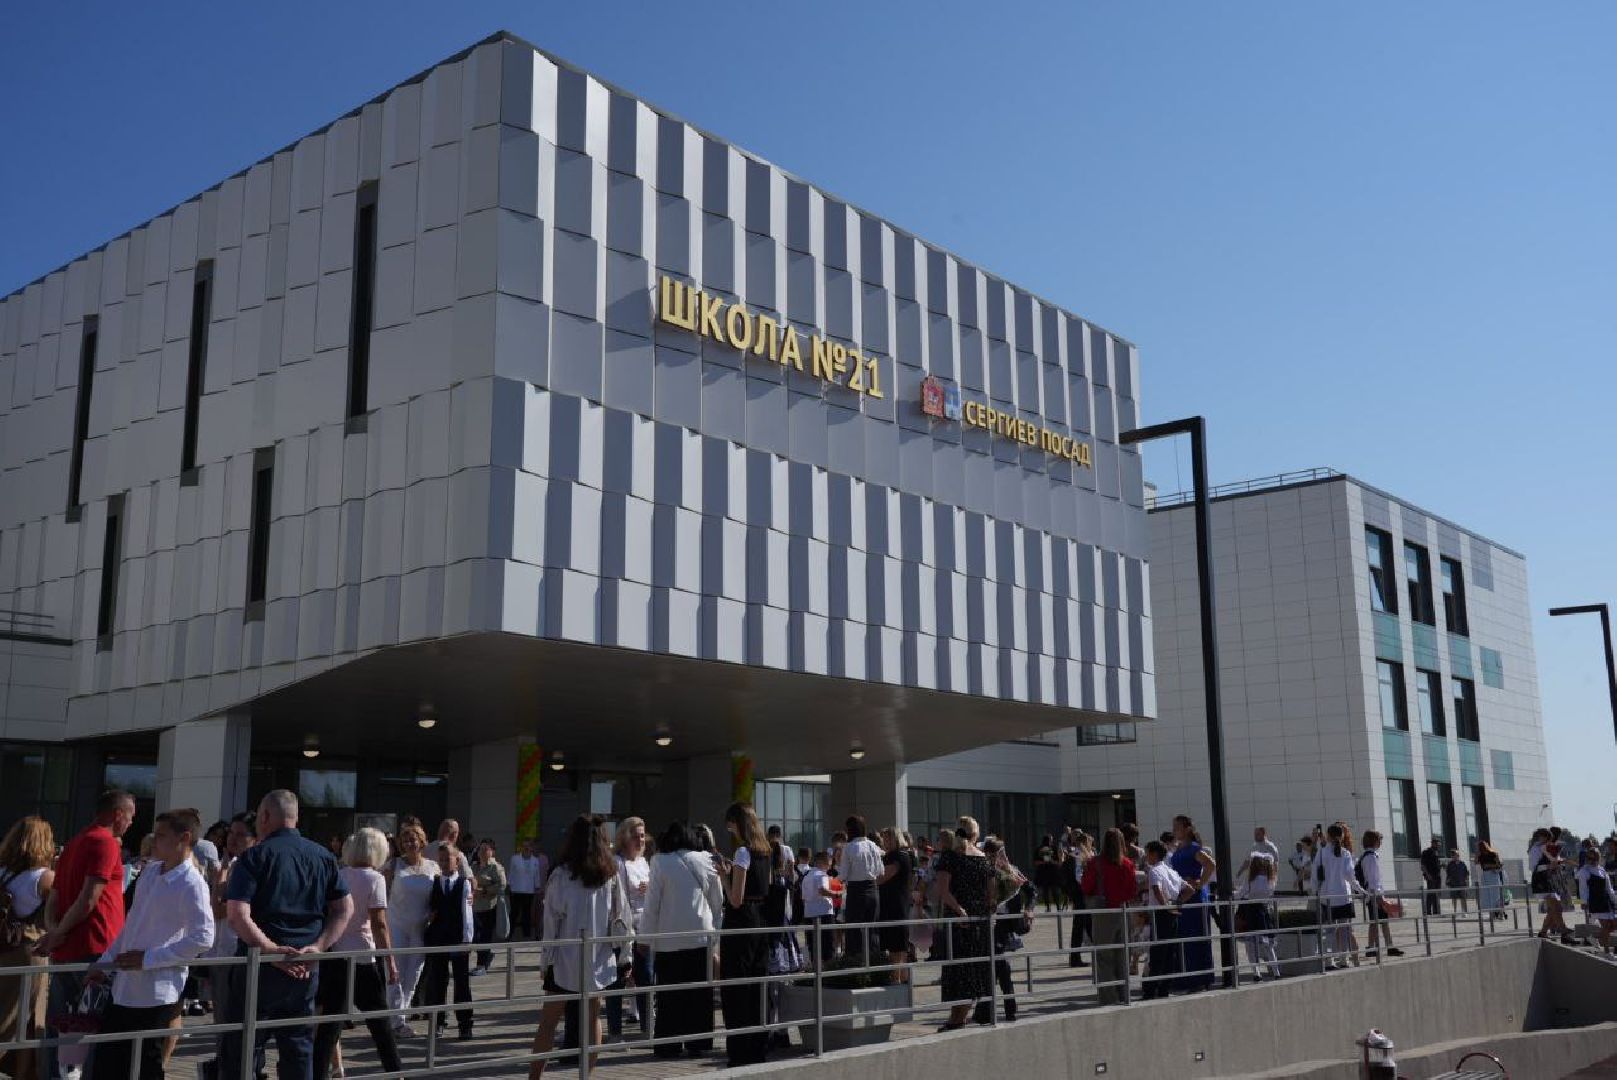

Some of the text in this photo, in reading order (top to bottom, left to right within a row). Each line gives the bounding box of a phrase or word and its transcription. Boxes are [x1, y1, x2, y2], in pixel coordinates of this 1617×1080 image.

[660, 275, 884, 398] ШКОЛА №21
[965, 400, 1091, 468] СЕРГИЕВ ПОСАД
